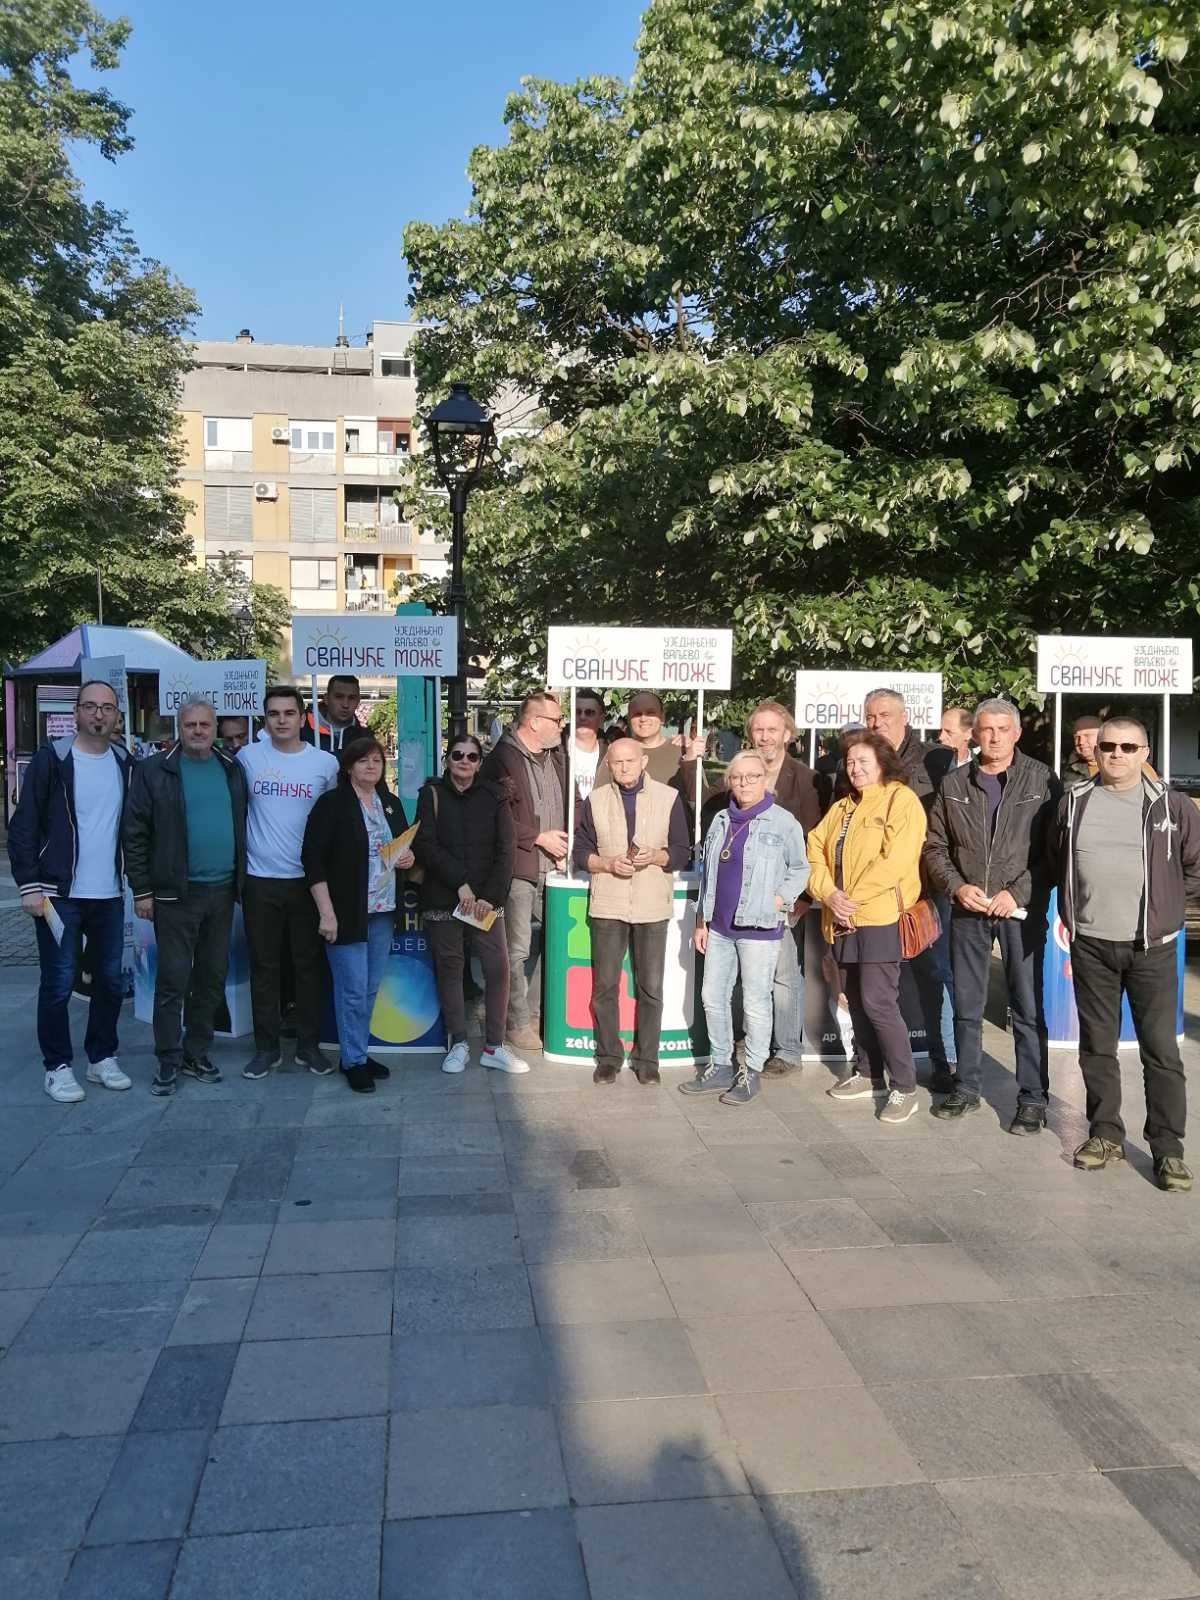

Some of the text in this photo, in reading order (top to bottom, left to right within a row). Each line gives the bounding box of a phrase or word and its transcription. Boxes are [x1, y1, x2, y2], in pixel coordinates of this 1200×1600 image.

[394, 636, 428, 647] ВАЉЕВО
[305, 646, 444, 668] СВАНУЋЕ МОЖЕ
[663, 649, 700, 660] ВАЉЕВО
[562, 658, 716, 683] СВАНУЋЕ МОЖЕ
[1050, 665, 1179, 688] СВАНУЋЕ МОЖЕ
[223, 692, 258, 710] МОЖЕ
[254, 780, 313, 798] СВАНУЋЕ
